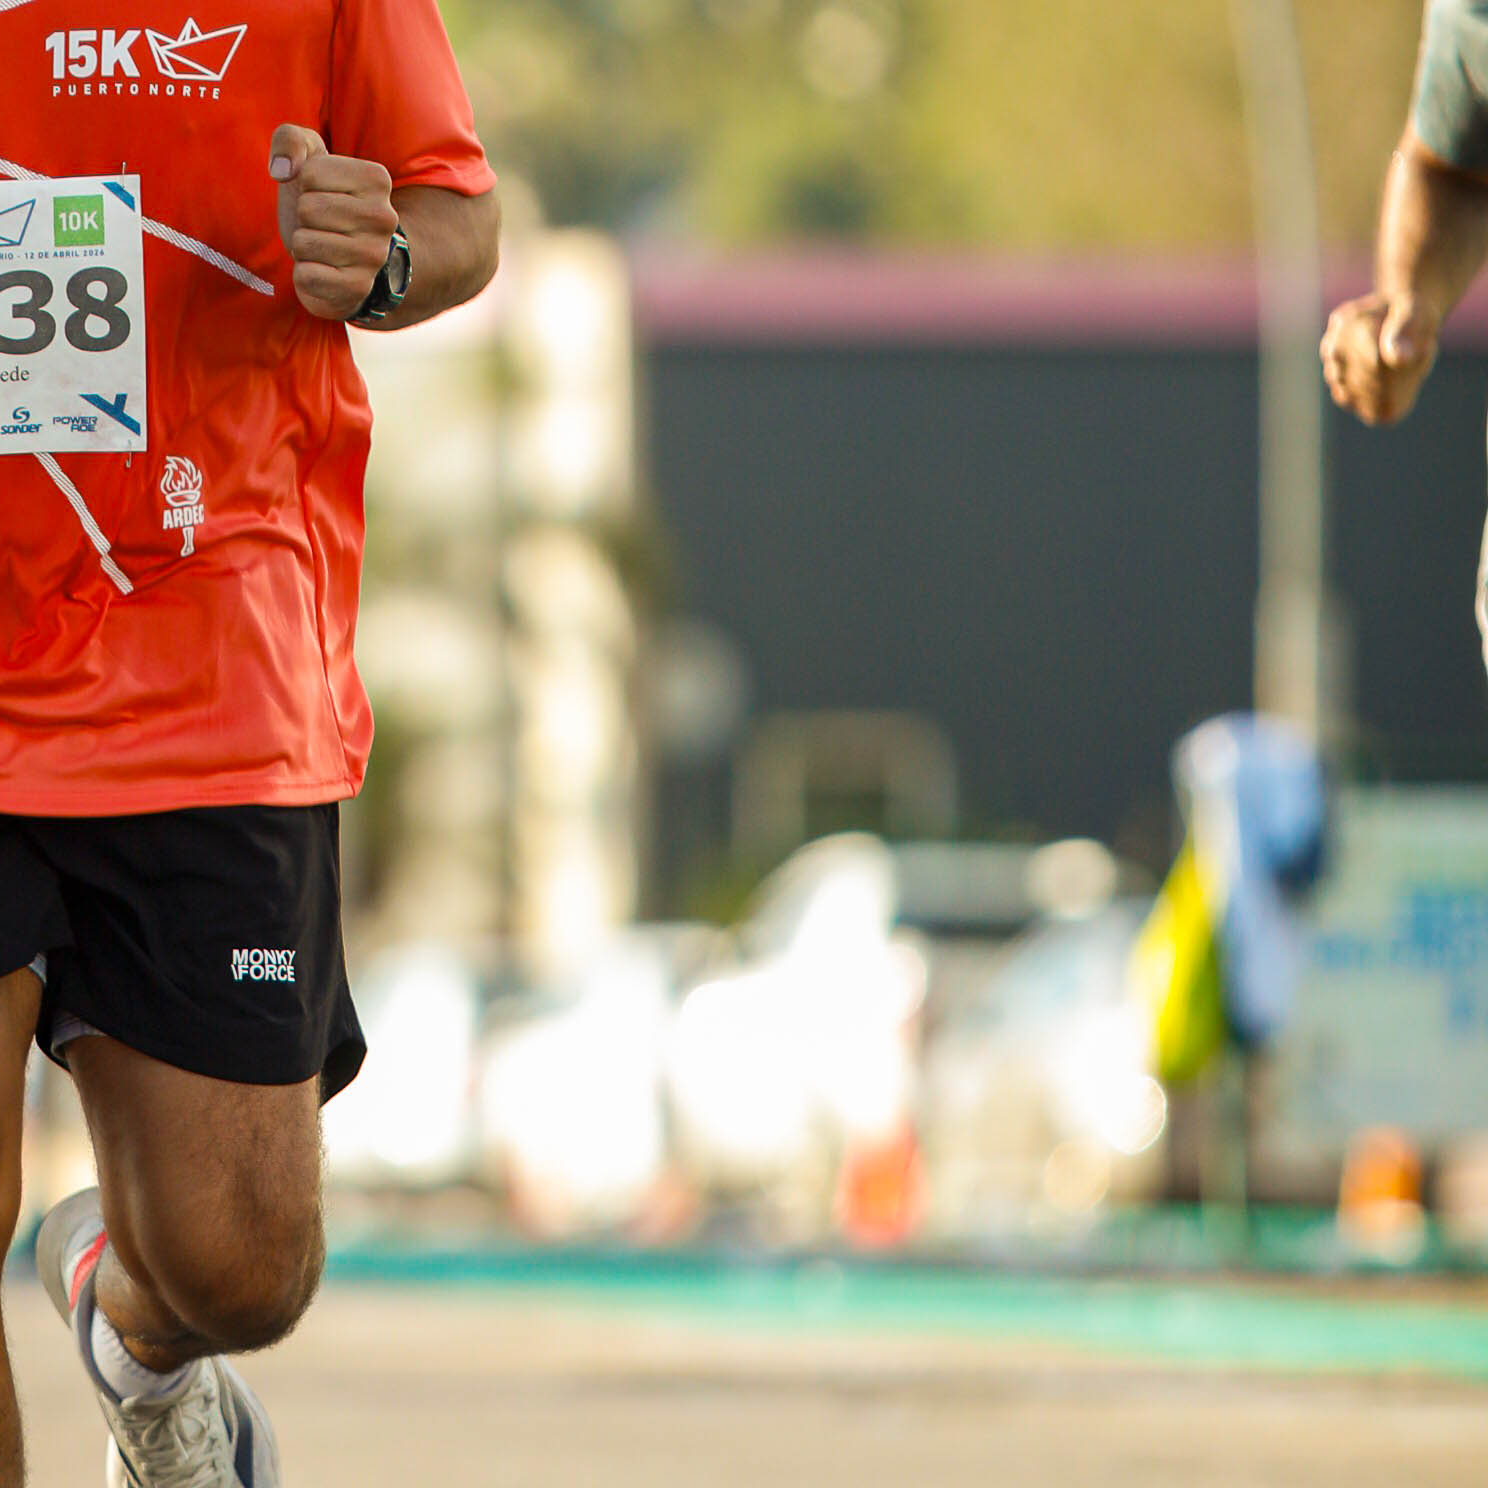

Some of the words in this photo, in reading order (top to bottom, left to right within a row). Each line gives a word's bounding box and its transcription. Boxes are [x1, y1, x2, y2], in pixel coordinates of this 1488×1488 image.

[45, 29, 142, 79] 15K
[59, 211, 99, 232] 10K
[25, 251, 35, 260] 12
[38, 250, 49, 259] DE
[53, 249, 79, 258] ABRIL
[83, 248, 105, 257] 2026
[232, 948, 296, 965] MONKY
